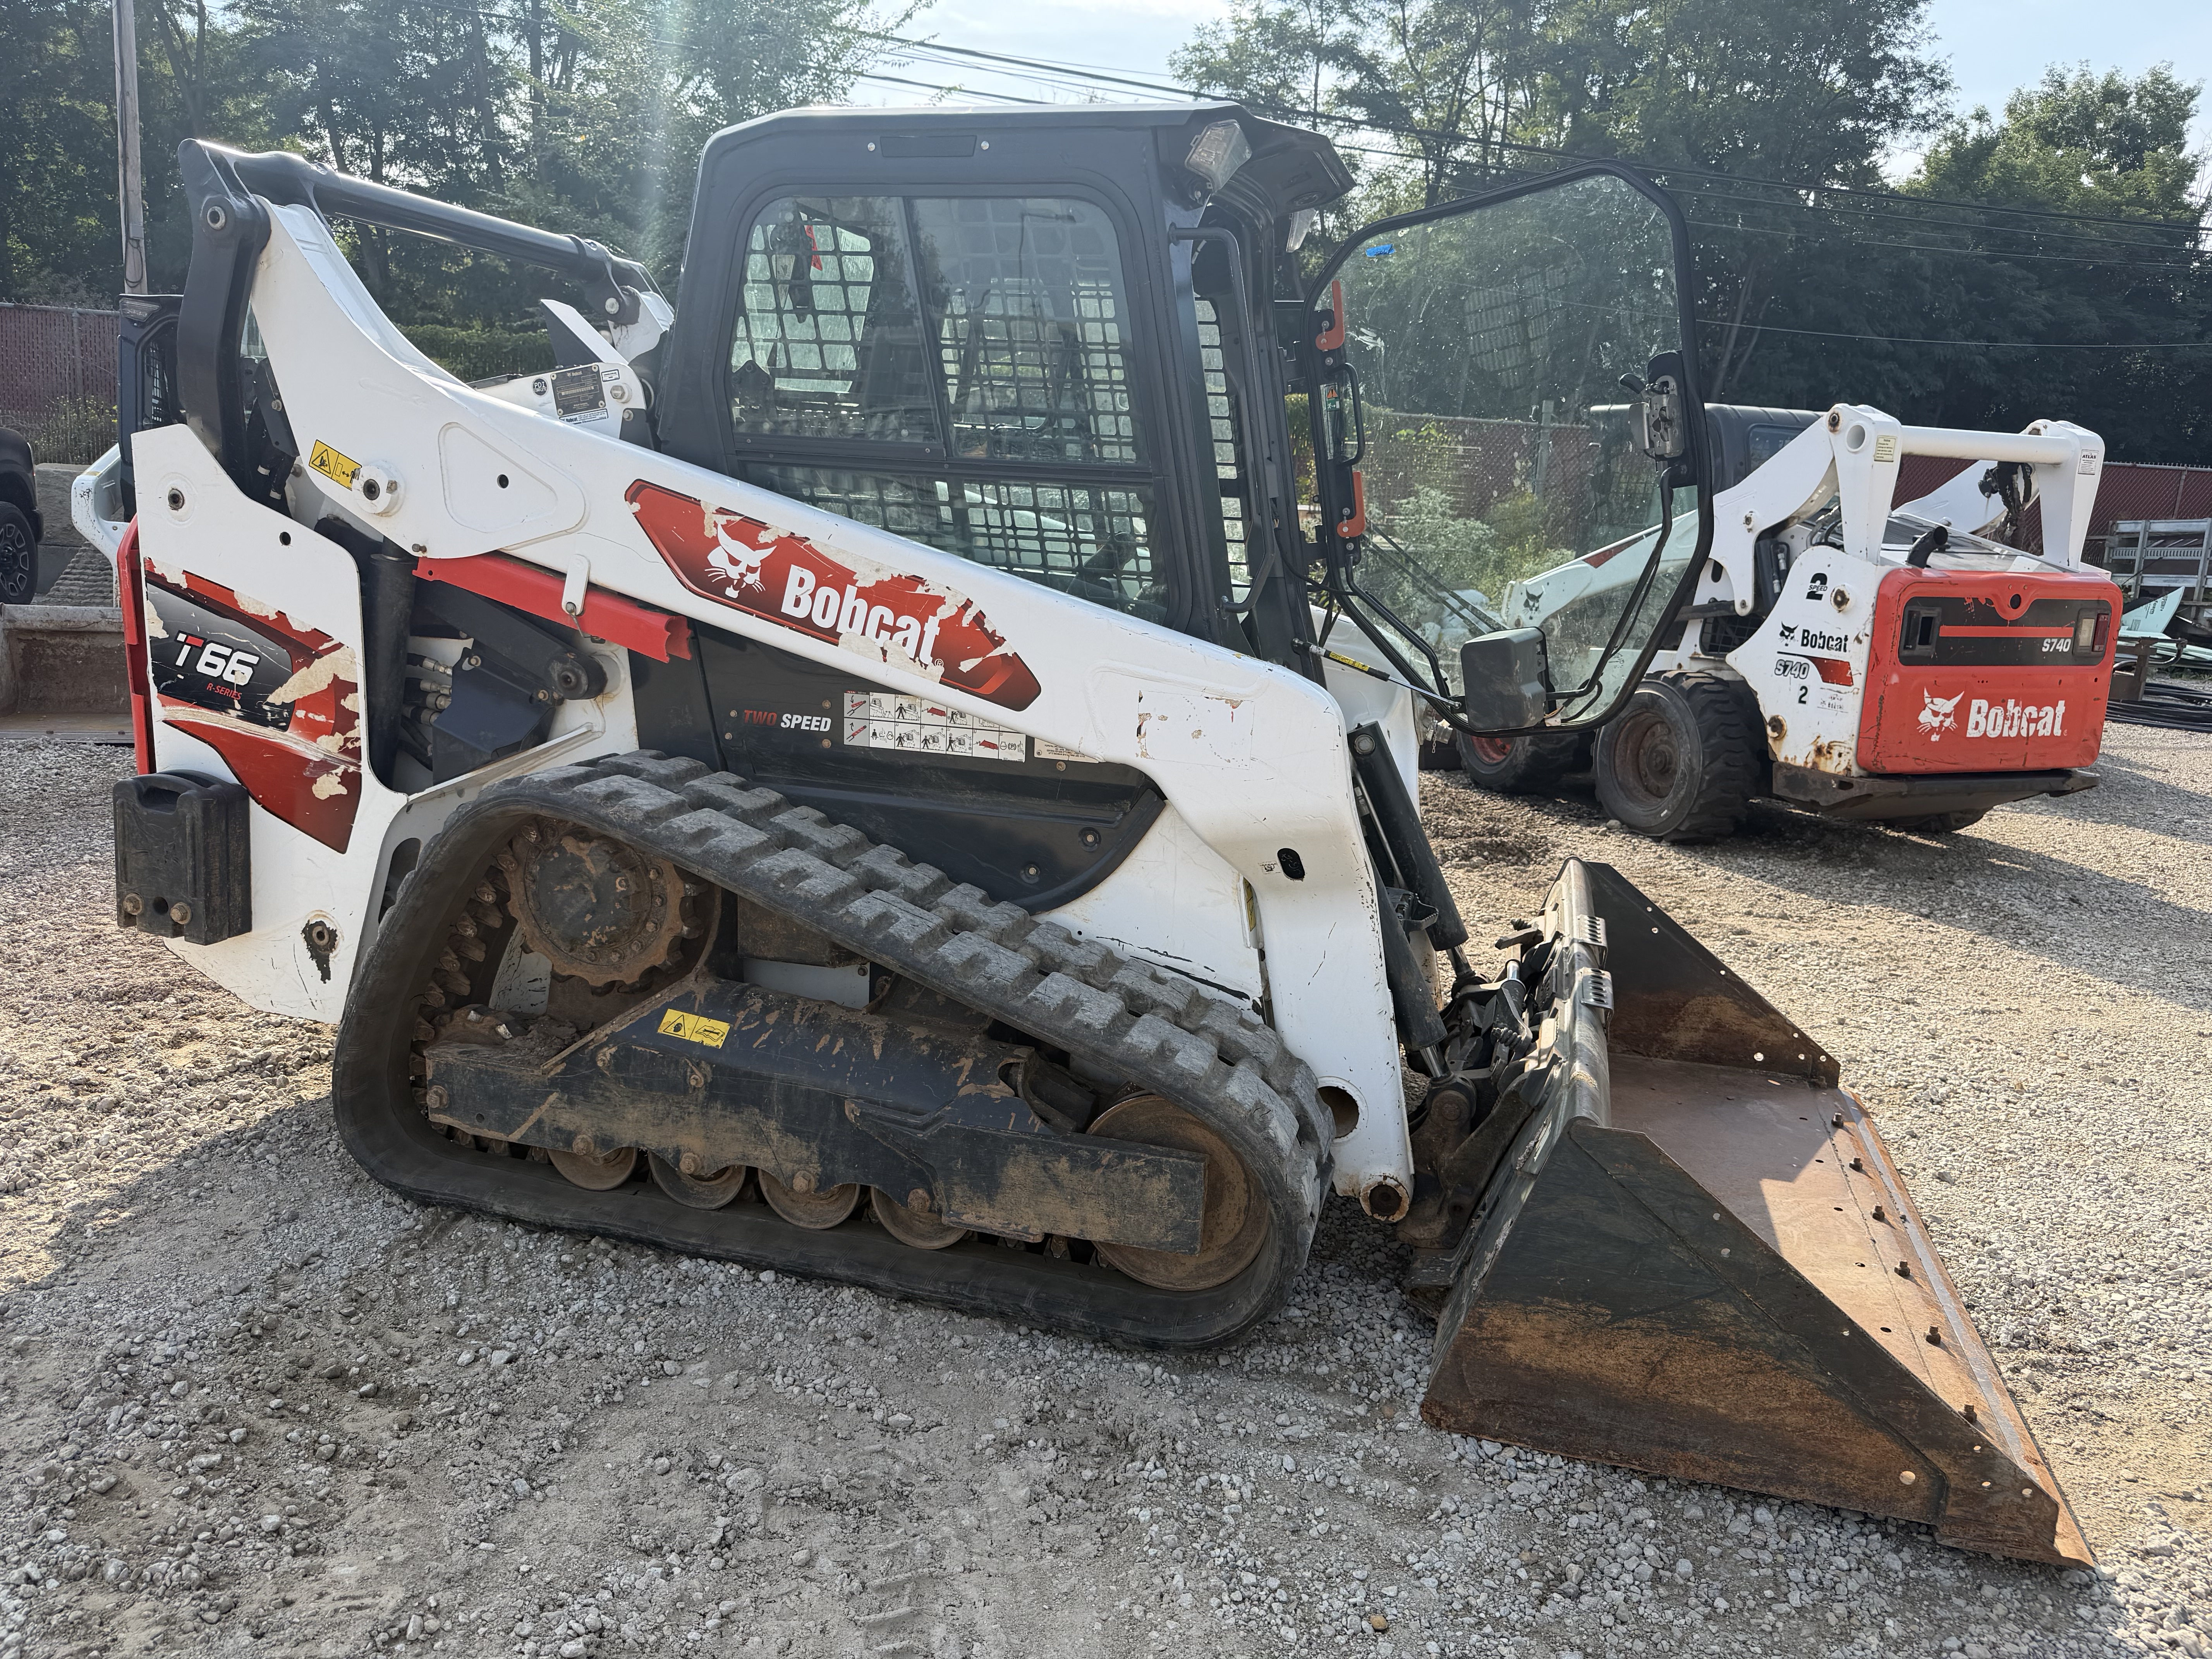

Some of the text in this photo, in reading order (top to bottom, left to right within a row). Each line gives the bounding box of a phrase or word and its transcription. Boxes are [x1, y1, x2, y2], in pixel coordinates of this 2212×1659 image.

[1806, 573, 1827, 600] 2
[781, 564, 940, 665] Bobcat
[1801, 629, 1848, 653] Bobcat
[2042, 639, 2071, 652] S740
[175, 633, 259, 685] T66
[1774, 659, 1810, 680] S740
[206, 683, 242, 700] R-SERIES
[1798, 686, 1808, 704] 2
[743, 709, 831, 733] TWO SPEED
[1966, 699, 2065, 738] Bobcat
